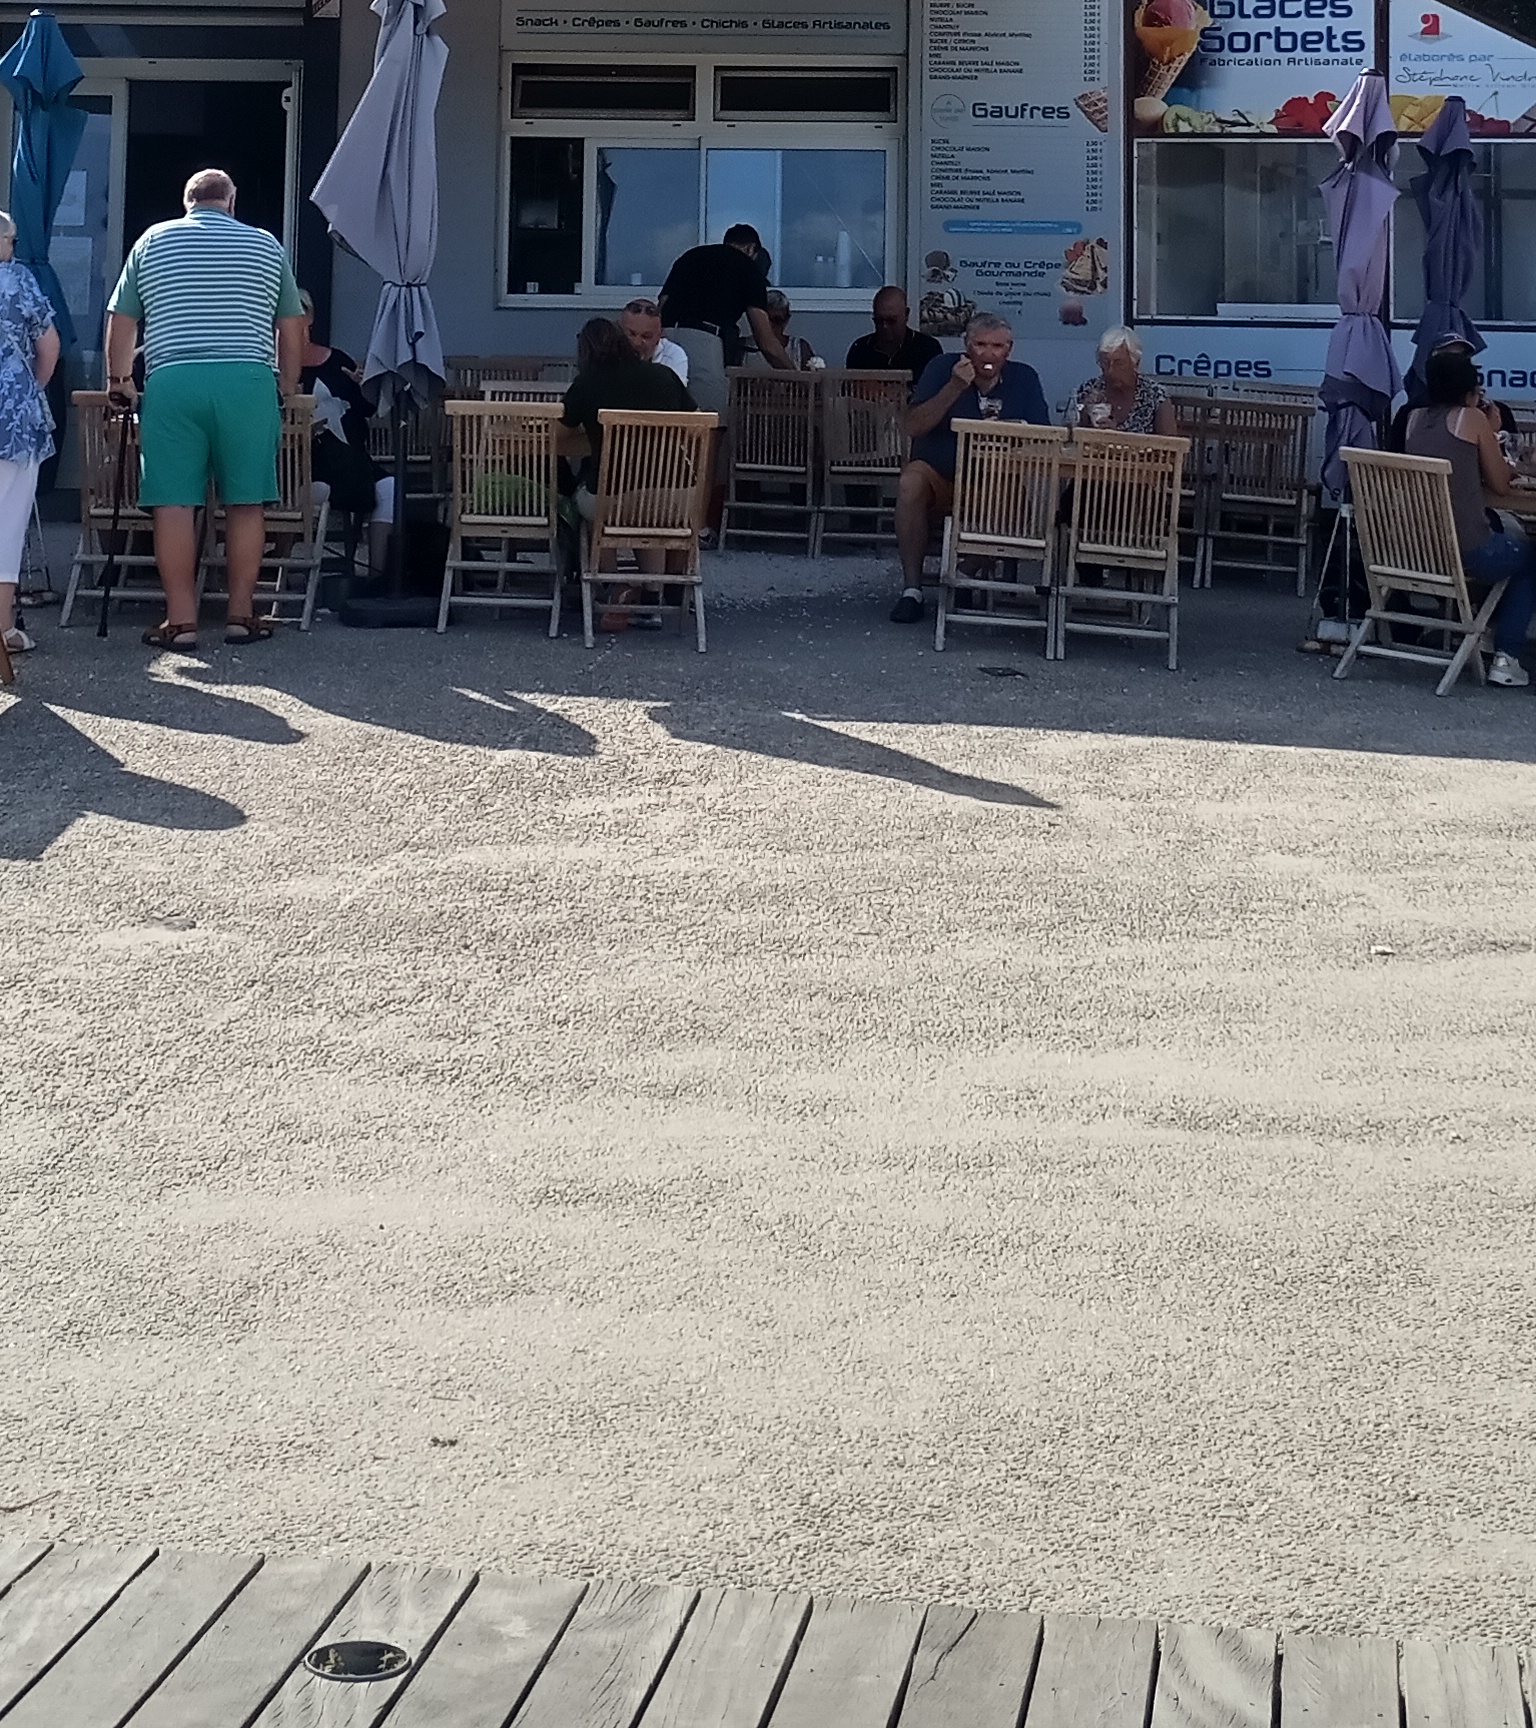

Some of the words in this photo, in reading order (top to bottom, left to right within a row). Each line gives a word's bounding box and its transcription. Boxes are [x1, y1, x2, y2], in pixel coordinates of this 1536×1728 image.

[515, 16, 559, 27] Snack
[571, 15, 621, 30] Crêpes
[633, 17, 687, 29] Gaufres
[700, 18, 749, 30] Chichis
[761, 19, 809, 30] Glaces
[812, 19, 891, 31] Artisanales
[1199, 26, 1365, 54] Sorbets
[1200, 56, 1281, 67] Fabrication
[1286, 56, 1364, 67] Artisanale
[1399, 52, 1465, 63] élaborés
[1468, 54, 1494, 64] par
[971, 102, 1071, 119] Gaufres
[959, 259, 1002, 269] Gaufre
[1023, 259, 1062, 271] Crêpe
[975, 269, 1047, 278] Gourmande
[1154, 353, 1273, 379] Crêpes
